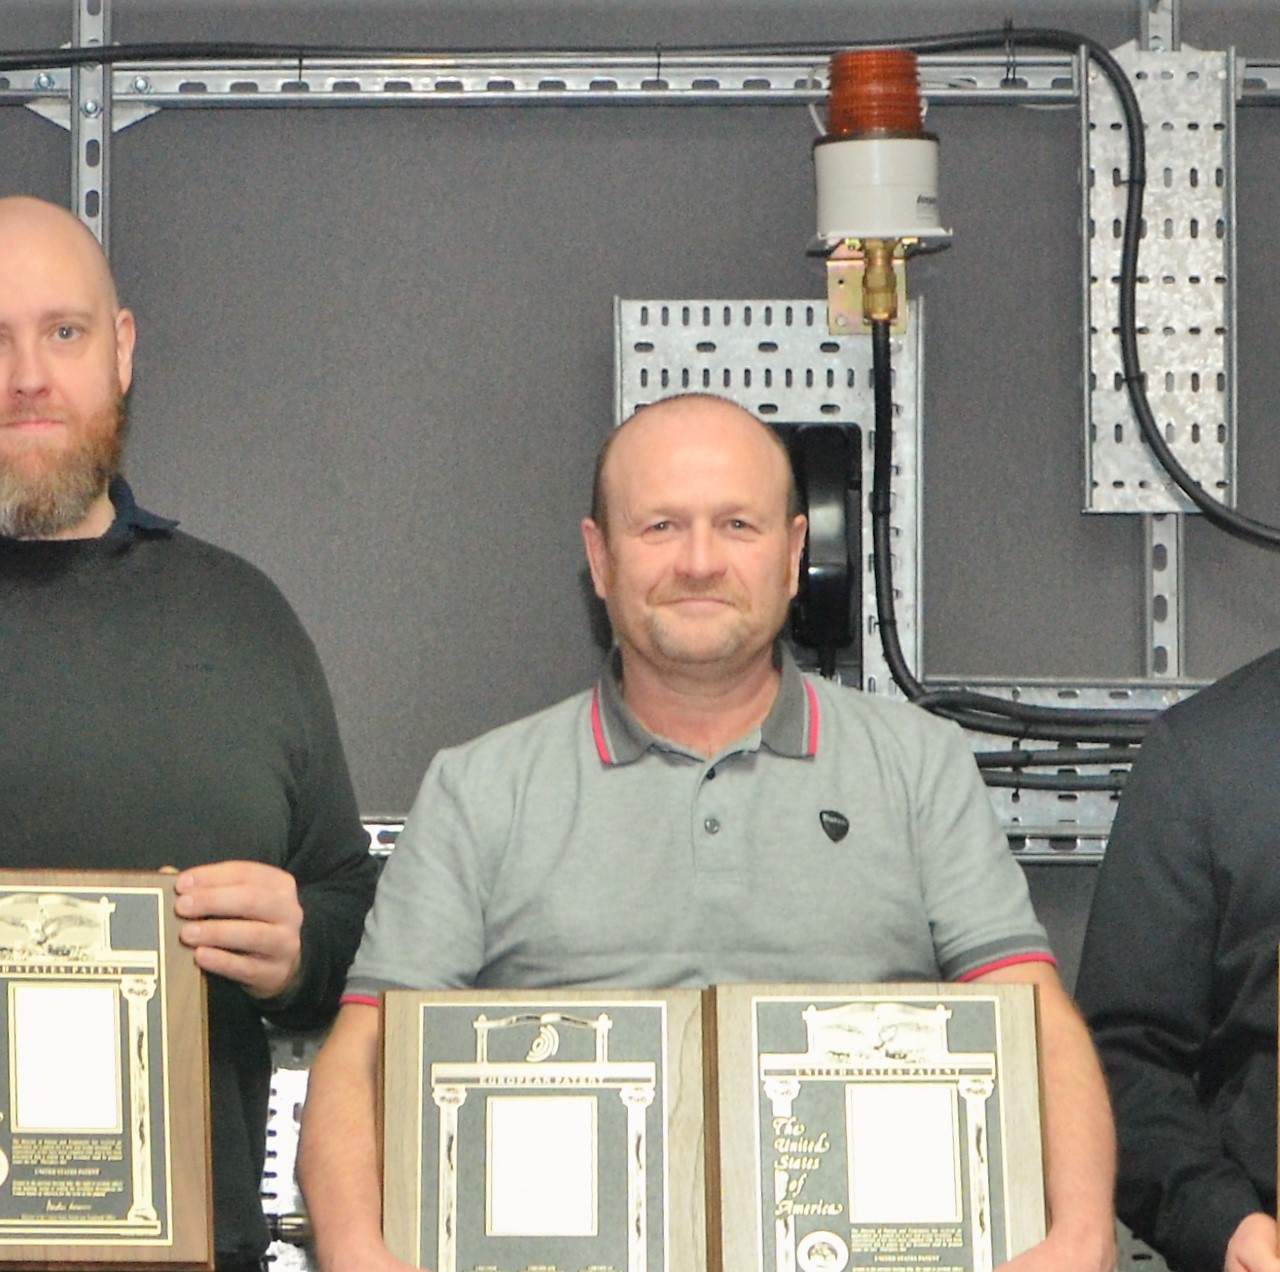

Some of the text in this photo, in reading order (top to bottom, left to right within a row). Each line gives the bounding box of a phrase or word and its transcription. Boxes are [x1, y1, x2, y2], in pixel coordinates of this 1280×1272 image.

[773, 1116, 805, 1136] The
[774, 1132, 830, 1153] United
[774, 1154, 820, 1170] States
[789, 1173, 808, 1198] of
[775, 1199, 843, 1216] America
